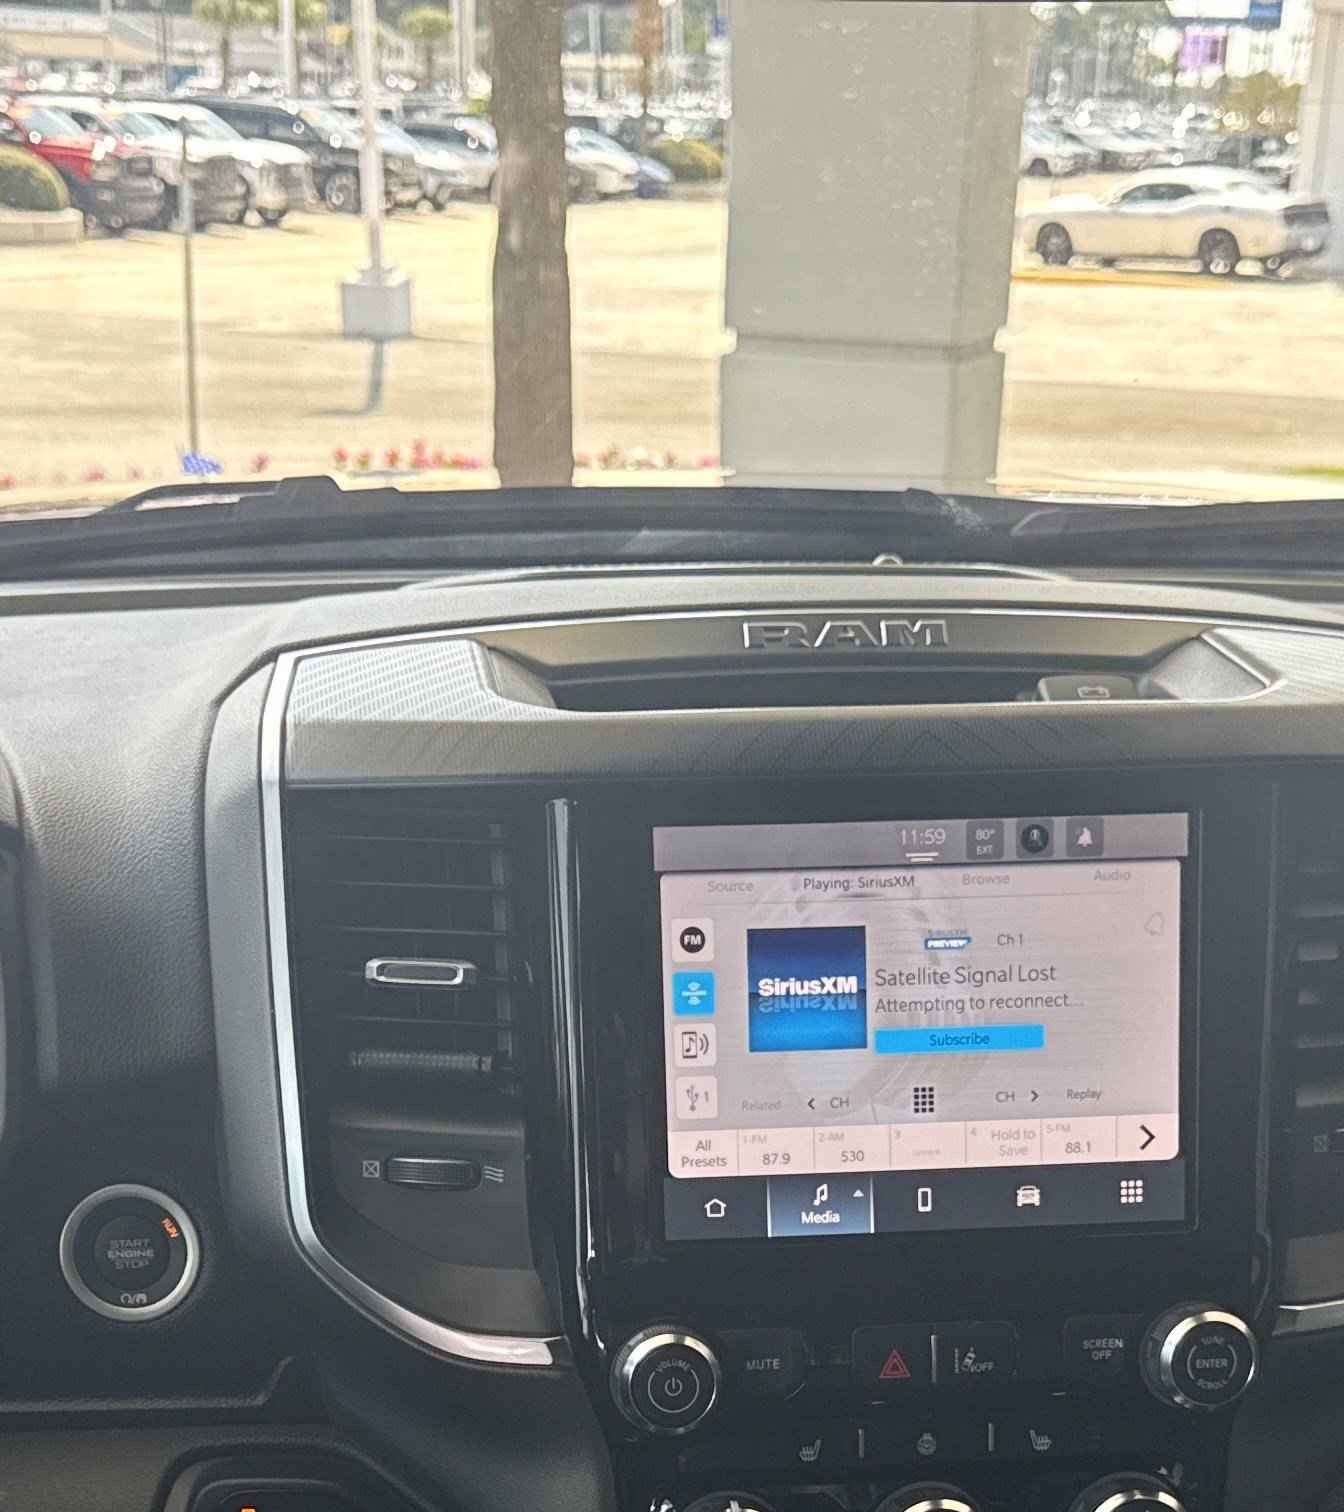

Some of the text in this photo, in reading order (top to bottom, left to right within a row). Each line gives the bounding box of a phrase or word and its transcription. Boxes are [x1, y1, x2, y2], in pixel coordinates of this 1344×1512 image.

[743, 619, 949, 649] RAM
[900, 828, 947, 846] 11:59
[976, 844, 993, 856] EXT
[962, 872, 1010, 886] Browse
[1093, 868, 1131, 882] Audio
[708, 880, 754, 893] Source
[803, 875, 915, 892] Playing: SiriusXM
[683, 934, 702, 946] FM
[997, 933, 1024, 946] Ch 1
[875, 963, 1057, 988] Satellite Signal Lost
[757, 975, 858, 997] SiriusXM
[875, 994, 966, 1014] Attempting
[970, 994, 986, 1010] to
[929, 1032, 991, 1047] Subscribe
[995, 1090, 1016, 1103] CH
[1066, 1088, 1102, 1102] Replay
[741, 1099, 782, 1112] Related
[829, 1096, 850, 1110] CH
[819, 1131, 845, 1143] 2-AM
[991, 1126, 1036, 1142] Hold to
[696, 1139, 712, 1152] All
[998, 1143, 1028, 1156] Save
[1065, 1141, 1092, 1155] 88.1
[681, 1155, 728, 1169] Presets
[762, 1152, 792, 1166] 87.9
[840, 1150, 865, 1163] 530
[801, 1210, 841, 1224] Media
[109, 1238, 150, 1249] START
[107, 1249, 155, 1259] ENGINE
[114, 1259, 150, 1270] STOP
[1082, 1338, 1124, 1350] SCREEN
[1091, 1350, 1113, 1361] OFF
[656, 1358, 692, 1374] VOLUME
[746, 1358, 781, 1371] MUTE
[974, 1361, 995, 1373] OFF
[1195, 1357, 1229, 1370] ENTER
[1197, 1377, 1229, 1391] SCROLL
